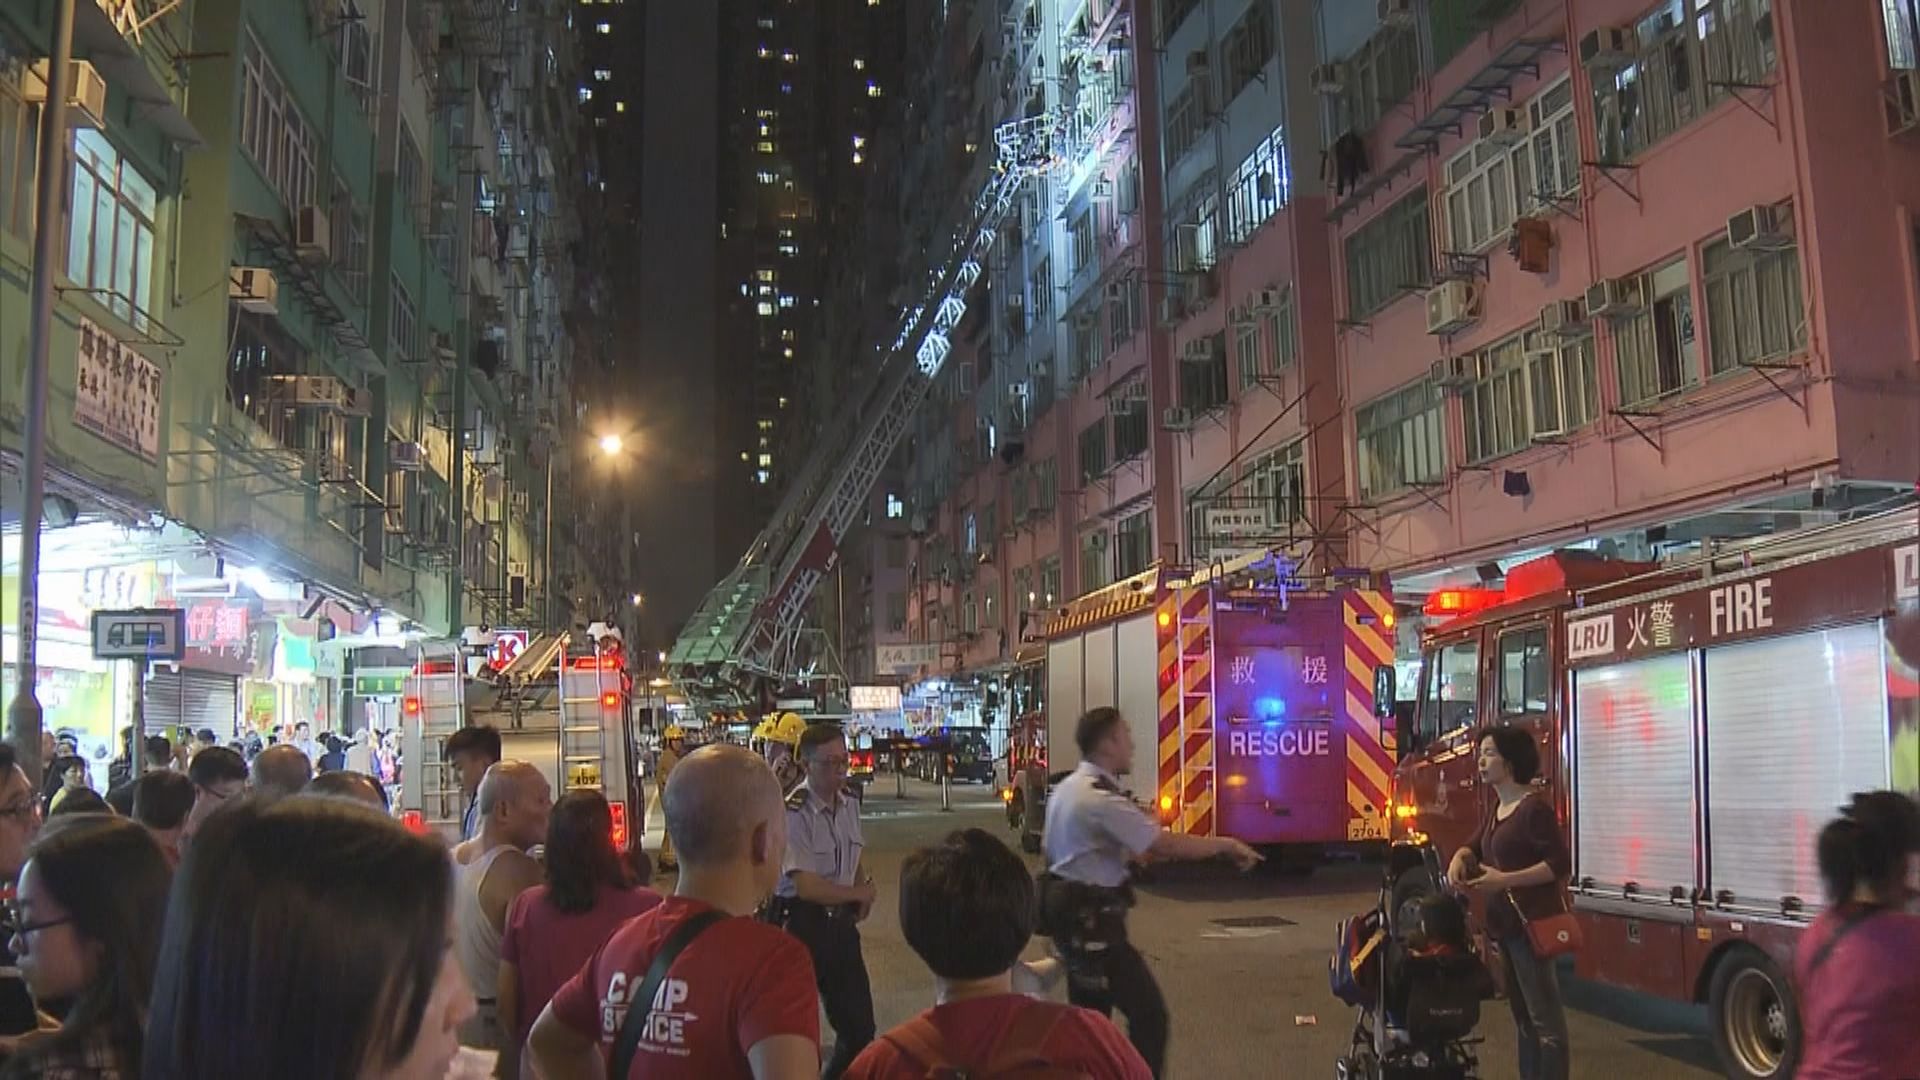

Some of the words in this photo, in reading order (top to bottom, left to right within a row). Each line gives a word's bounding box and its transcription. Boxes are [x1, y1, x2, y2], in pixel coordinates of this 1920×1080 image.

[1573, 620, 1609, 653] LRU
[1626, 600, 1675, 650] 火警
[1709, 578, 1773, 638] FIRE
[1230, 729, 1329, 756] RESCUE
[1352, 828, 1382, 838] 2704
[607, 971, 689, 1012] CP
